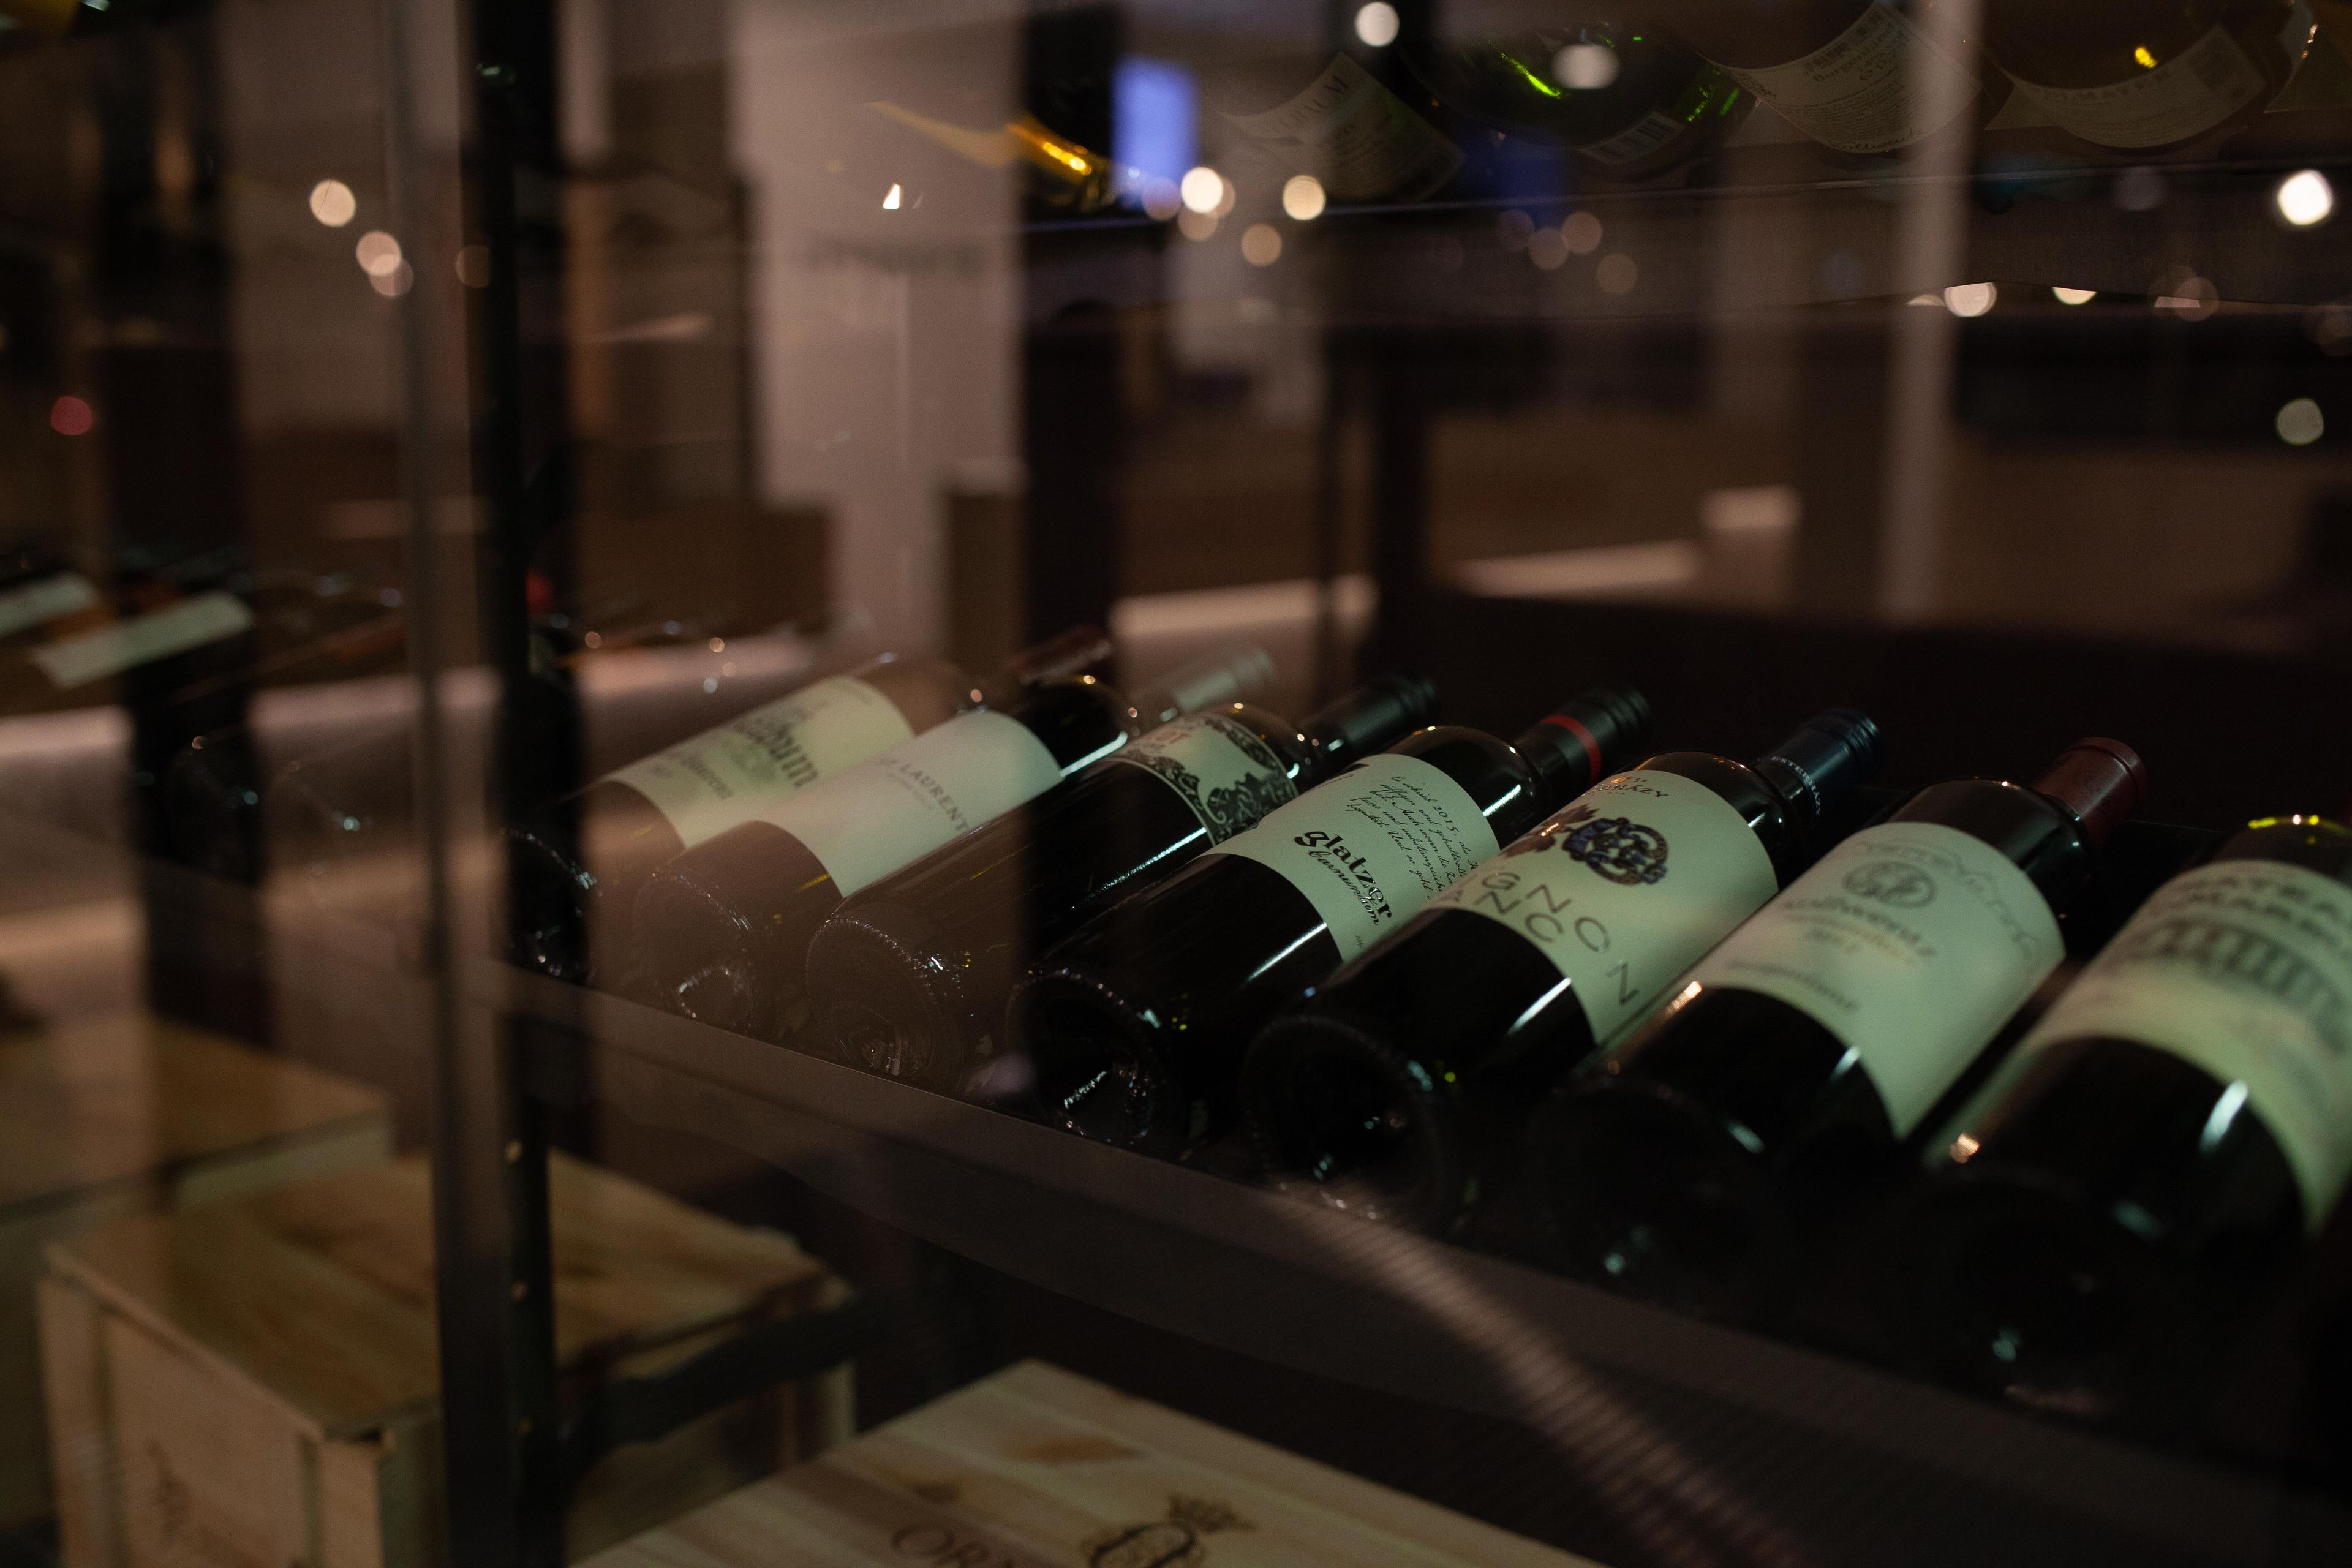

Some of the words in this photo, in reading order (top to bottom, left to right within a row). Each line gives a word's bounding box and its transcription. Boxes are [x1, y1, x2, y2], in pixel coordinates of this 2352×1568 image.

[1812, 22, 1896, 83] Burgenland
[899, 763, 970, 832] LAURENT
[1382, 810, 1409, 826] und
[1419, 809, 1442, 826] und
[1432, 805, 1460, 837] 2015,
[1387, 829, 1412, 851] Und
[1392, 801, 1424, 827] Auch
[1420, 829, 1439, 853] wenn
[1438, 855, 1450, 869] die
[1406, 854, 1415, 866] so
[1294, 831, 1392, 919] glatzer
[1408, 869, 1433, 892] geht
